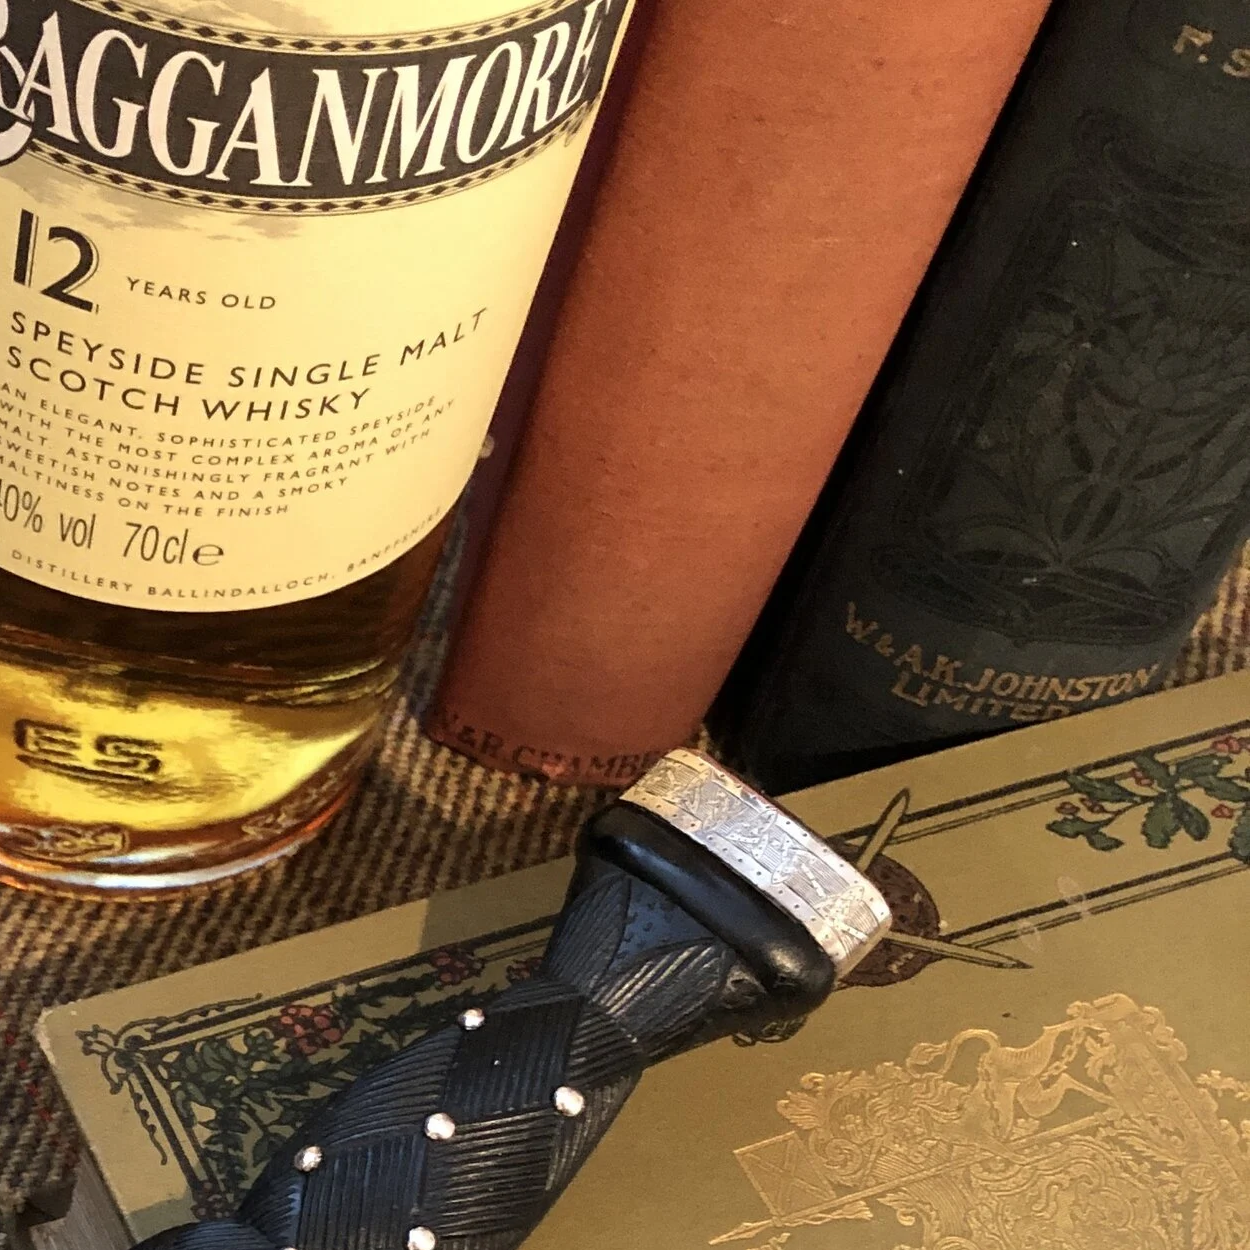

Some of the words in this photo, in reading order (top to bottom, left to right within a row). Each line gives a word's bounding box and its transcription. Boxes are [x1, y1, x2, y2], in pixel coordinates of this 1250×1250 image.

[13, 208, 100, 315] 12
[126, 276, 207, 305] YEARS
[221, 294, 276, 310] OLD
[11, 311, 205, 385] SPEYSIDE
[228, 353, 381, 388] SINGLE
[400, 307, 487, 367] MALT
[7, 346, 180, 416] SCOTCH
[202, 388, 370, 421] WHISKY
[0, 399, 51, 430] WITH
[65, 427, 104, 447] THE
[118, 443, 177, 461] MOST
[191, 454, 295, 466] COMPLEX
[308, 437, 378, 460] AROMA
[391, 423, 414, 438] OF
[422, 399, 454, 424] ANY
[1, 382, 27, 401] AN
[157, 431, 336, 448] SOPHISTICATED
[350, 396, 436, 436] SPEYSIDE
[66, 447, 250, 483] ASTONISHINGLY
[263, 453, 374, 482] FRAGRANT
[385, 429, 430, 455] WITH
[109, 478, 181, 497] NOTES
[194, 490, 240, 500] AND
[252, 490, 264, 499] A
[278, 477, 347, 498] SMOKY
[118, 497, 149, 510] ON
[163, 504, 203, 517] THE
[216, 505, 289, 517] FINISH
[59, 512, 96, 549] vol
[12, 550, 133, 592] DISTILLERY
[891, 671, 1071, 720] LIMITED
[964, 664, 1161, 702] JOHNSTON
